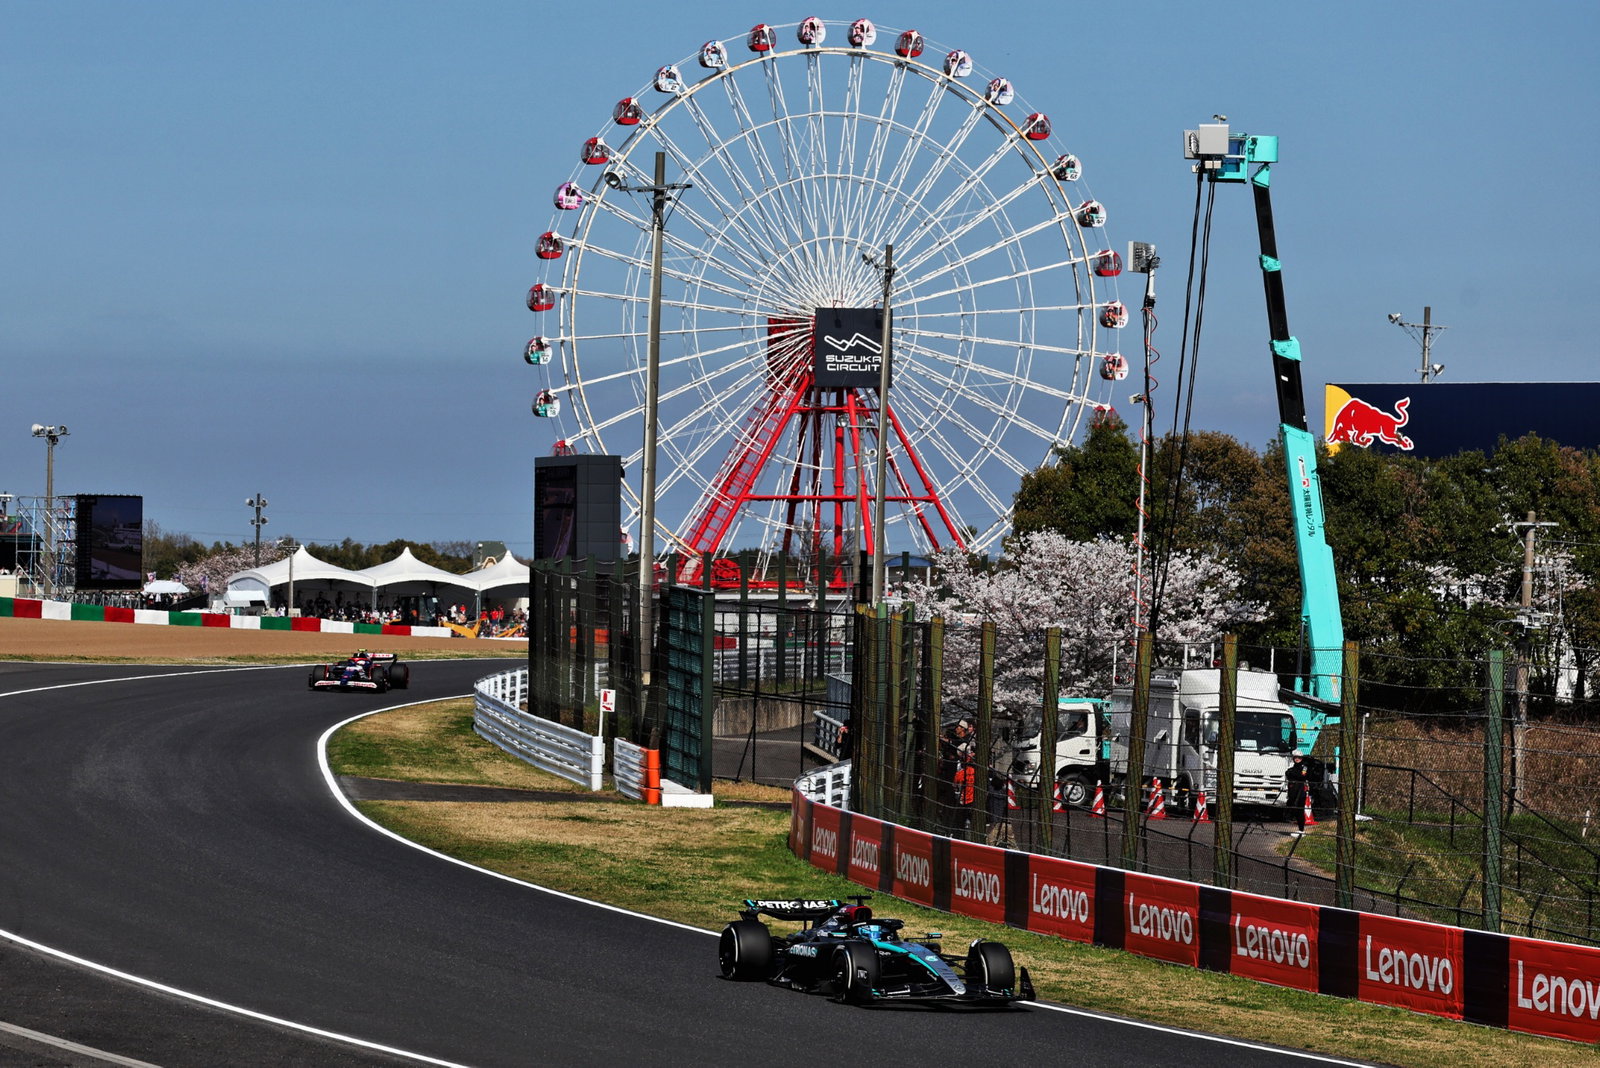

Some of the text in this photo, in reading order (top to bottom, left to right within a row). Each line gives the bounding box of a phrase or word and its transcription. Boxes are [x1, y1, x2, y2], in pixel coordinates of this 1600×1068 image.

[825, 354, 882, 363] SUZUKA
[826, 363, 880, 371] CIRCUIT
[812, 817, 838, 859] Lenovo
[851, 829, 879, 872] Lenovo
[896, 842, 931, 888] Lenovo
[954, 858, 1000, 905] Lenovo
[757, 900, 827, 910] PETRONAS
[1033, 872, 1089, 924] Lenovo
[1128, 892, 1194, 945] Lenovo
[1234, 913, 1310, 969] Lenovo
[1366, 934, 1454, 995] Lenovo
